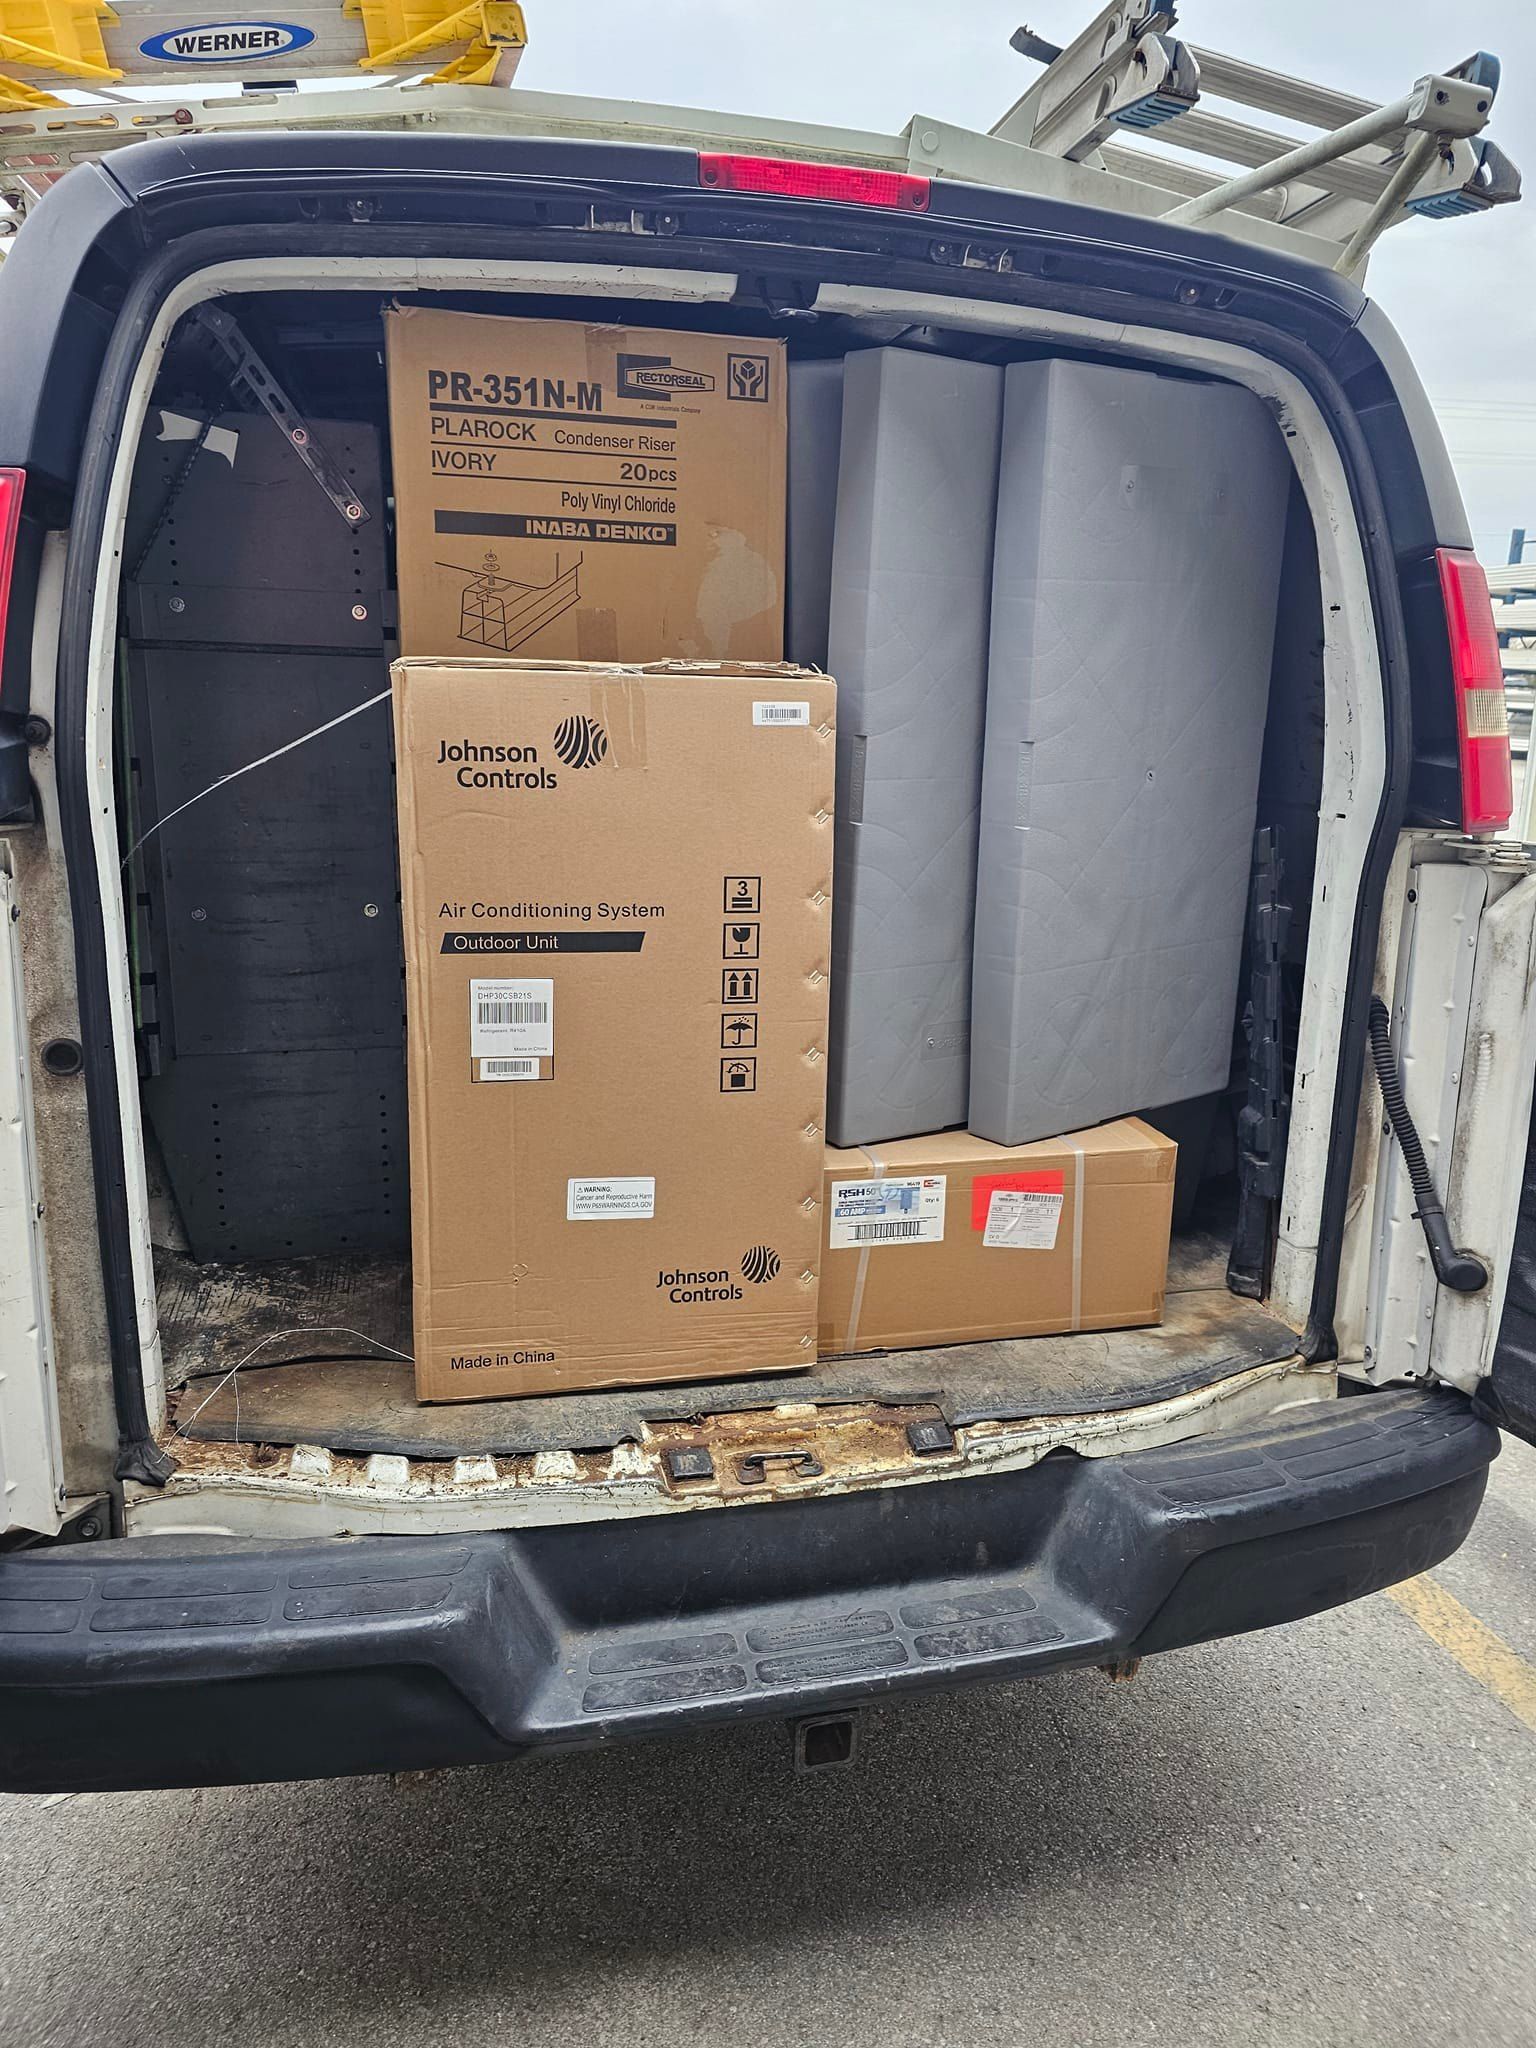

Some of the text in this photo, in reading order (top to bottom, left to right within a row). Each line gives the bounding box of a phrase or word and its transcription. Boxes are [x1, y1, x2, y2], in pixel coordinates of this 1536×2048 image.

[174, 30, 280, 54] WERNER
[636, 371, 706, 388] RECTORSEAL
[428, 369, 602, 412] PR-351N-M
[431, 416, 676, 452] PLAROCK Condenser Riser
[431, 449, 497, 471] IVORY
[561, 491, 676, 514] Poly Vinyl Chloride
[526, 519, 591, 538] INABA
[437, 738, 538, 764] Johnson
[456, 766, 558, 789] Controls
[737, 880, 749, 897] 3
[439, 902, 665, 922] Air Conditioning System
[453, 935, 559, 950] Outdoor Unit
[606, 1193, 638, 1201] Reproductive
[840, 1208, 850, 1216] 60
[656, 1269, 729, 1288] Johnson
[669, 1284, 743, 1304] Controls
[450, 1350, 555, 1370] Made in China
